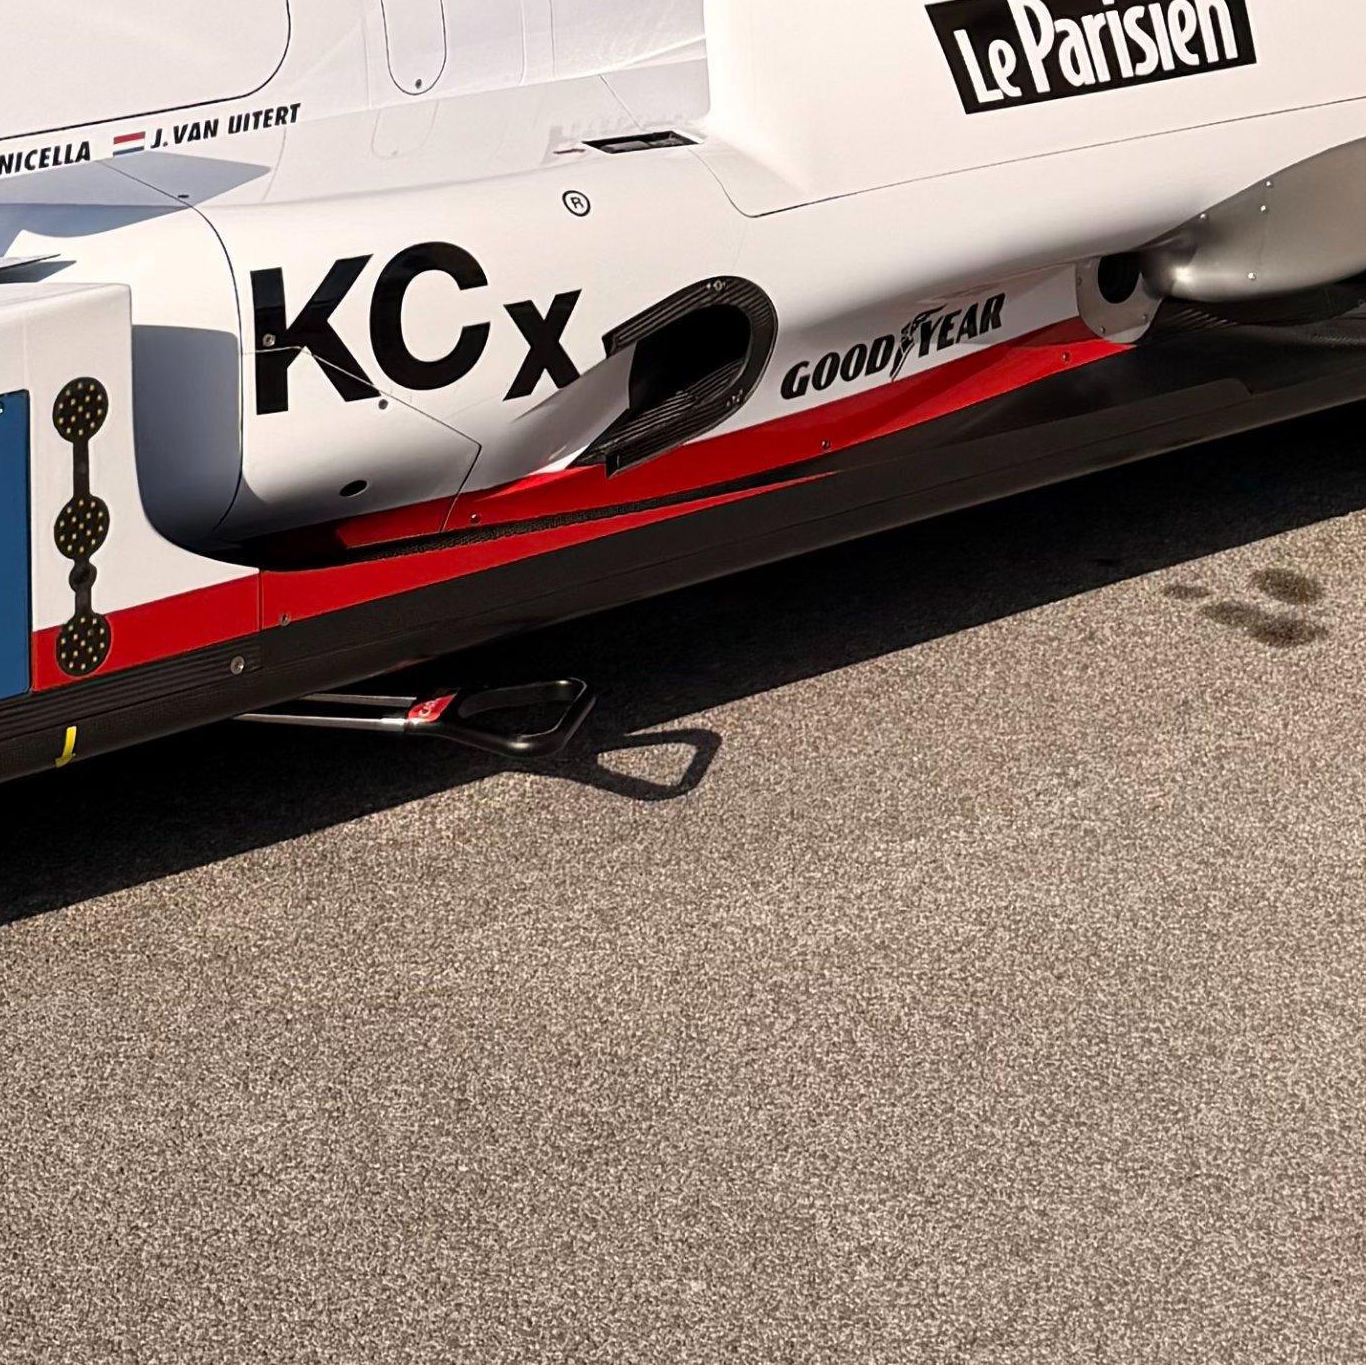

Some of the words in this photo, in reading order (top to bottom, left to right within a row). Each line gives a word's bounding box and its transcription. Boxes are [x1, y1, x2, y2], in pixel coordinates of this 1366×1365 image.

[952, 28, 1023, 104] Le
[150, 127, 170, 150] J.
[173, 119, 219, 145] VAN
[227, 102, 302, 135] UITERT
